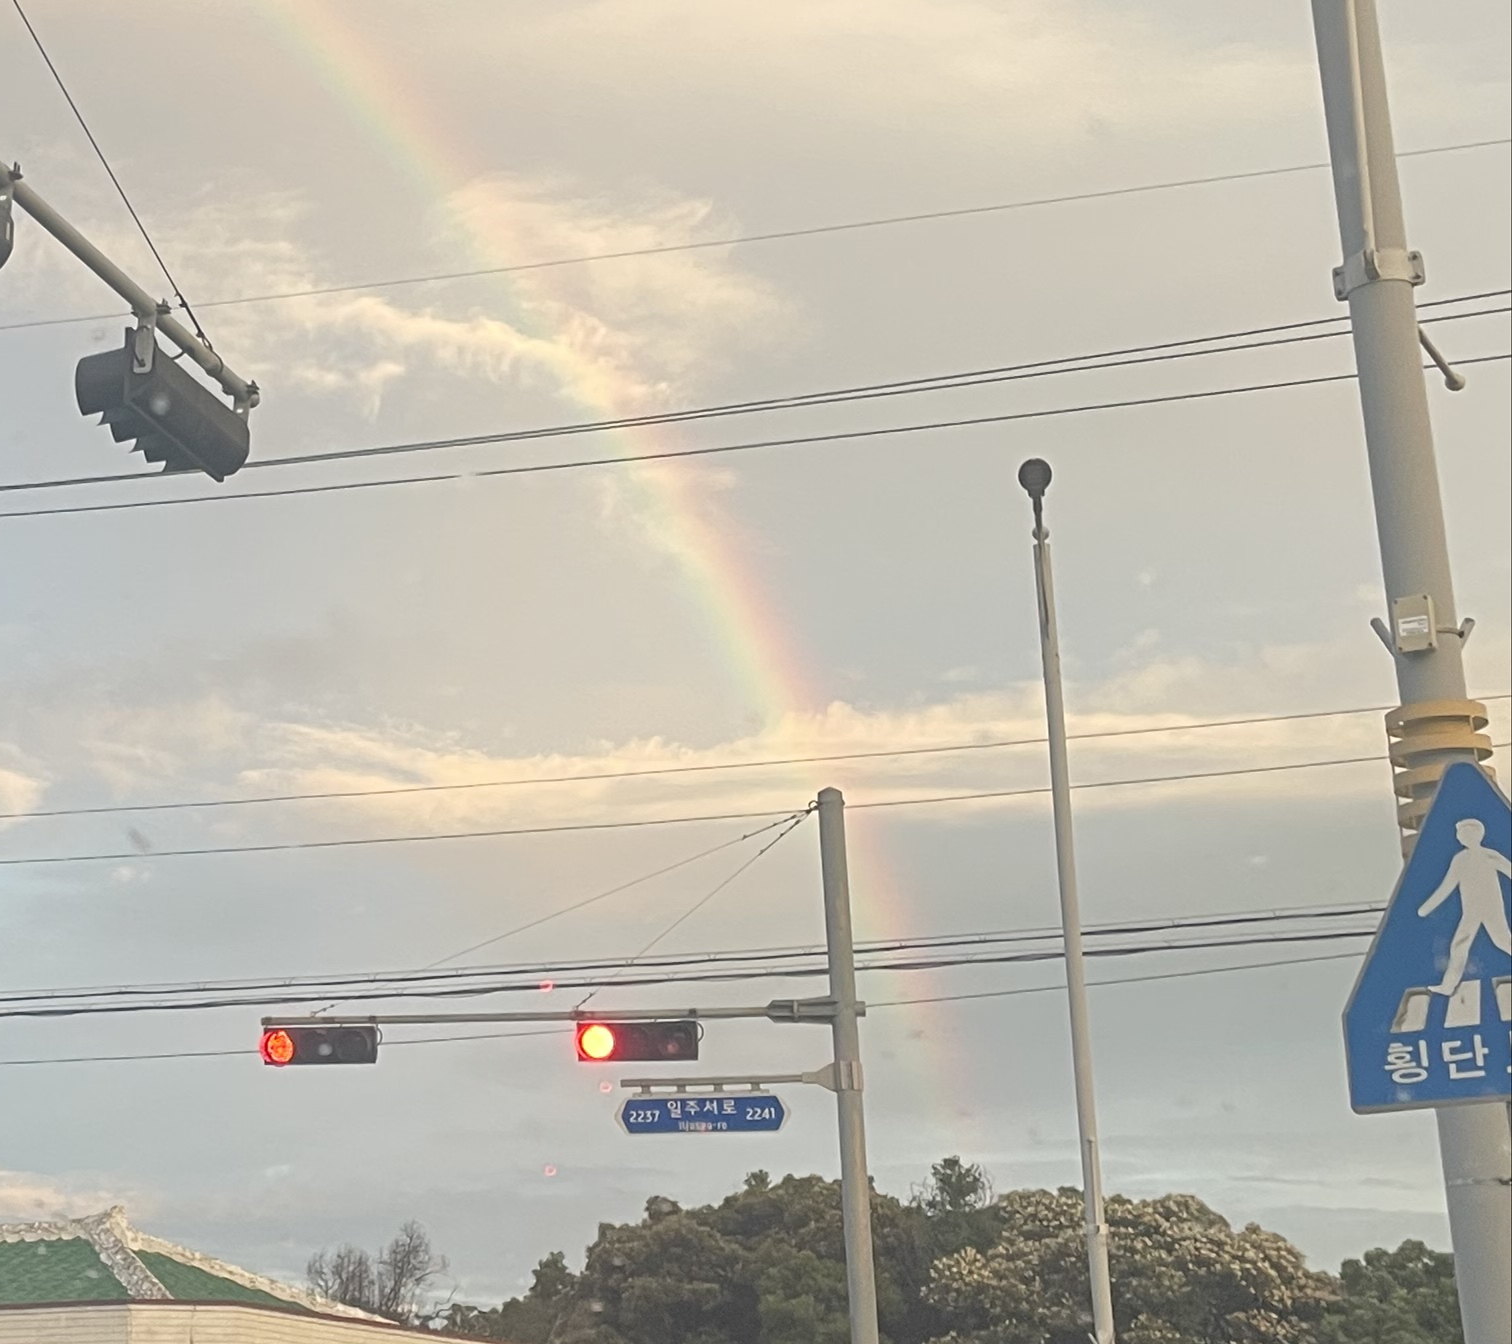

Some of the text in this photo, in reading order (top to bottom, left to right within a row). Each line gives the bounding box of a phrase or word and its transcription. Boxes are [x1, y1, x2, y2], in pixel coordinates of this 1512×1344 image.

[1384, 1030, 1511, 1084] 횡단
[629, 1110, 660, 1123] 2237
[667, 1099, 737, 1119] 일주서로
[745, 1107, 776, 1121] 2241
